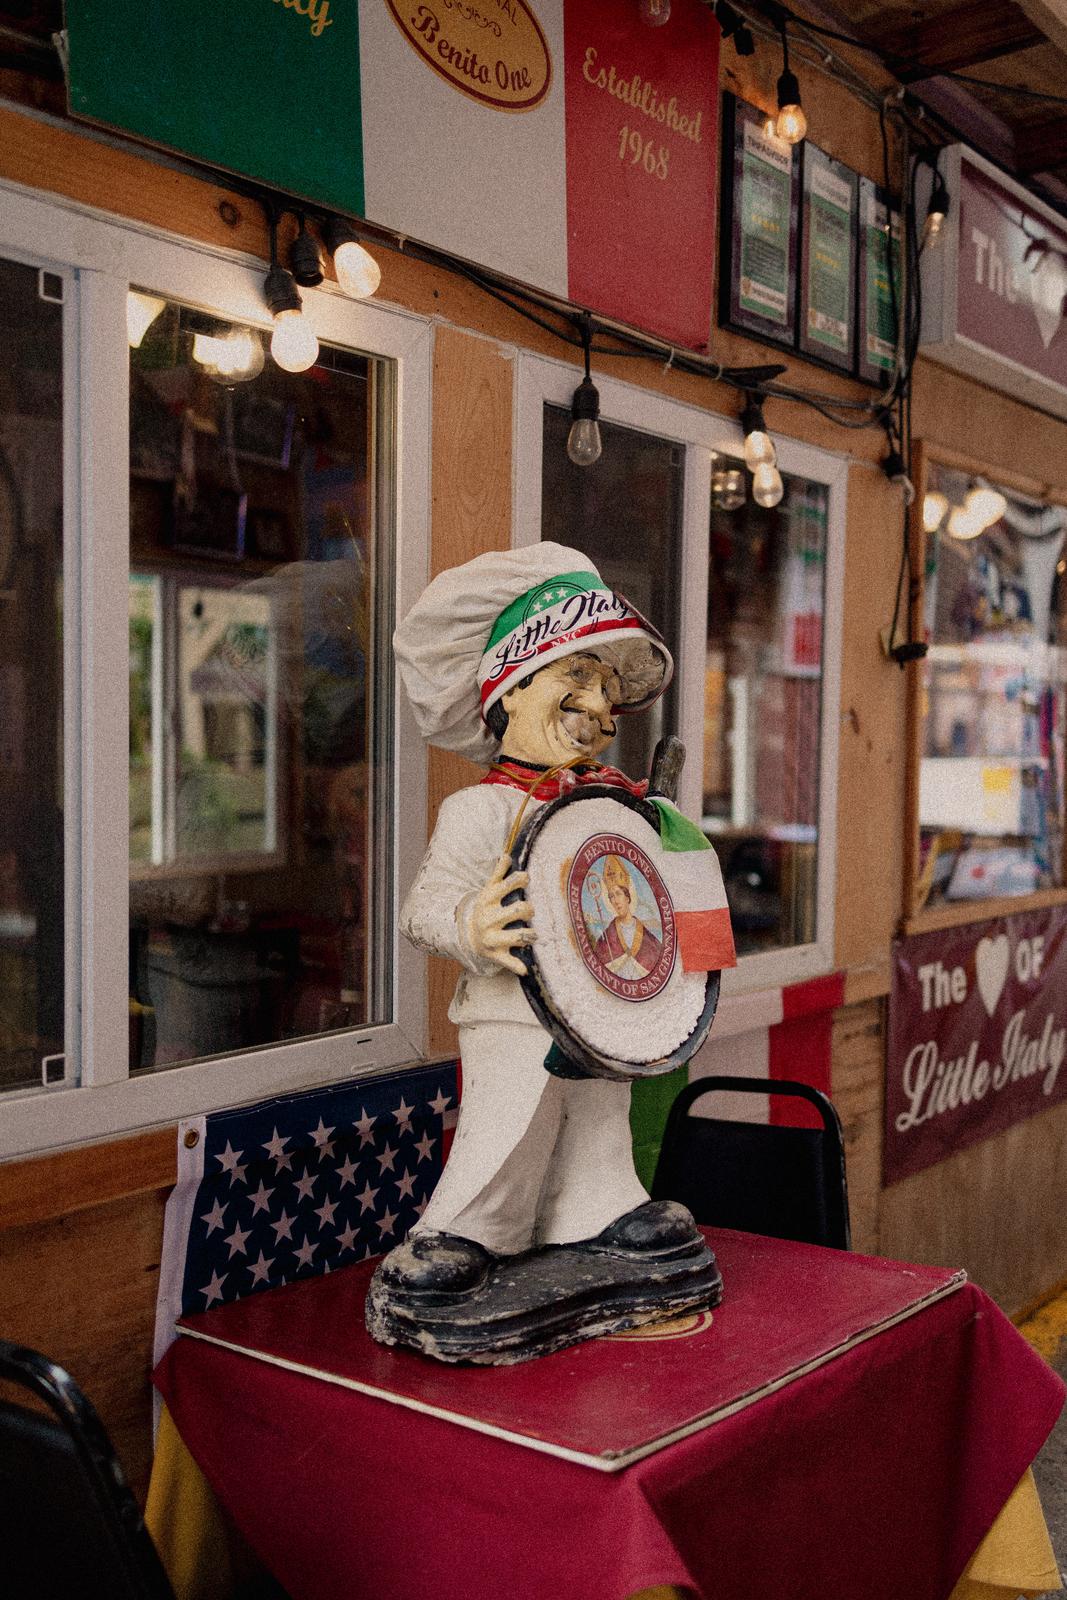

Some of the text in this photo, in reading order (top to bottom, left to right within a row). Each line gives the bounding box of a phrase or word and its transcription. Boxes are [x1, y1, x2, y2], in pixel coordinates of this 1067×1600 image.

[411, 5, 532, 90] Benito One
[583, 47, 705, 144] Established
[619, 126, 671, 181] 1968
[490, 591, 629, 680] Little Italy
[550, 629, 581, 648] NYC
[583, 839, 653, 878] BENITO ONE
[571, 885, 675, 995] RESTAURANT OF SAN GENNARO
[917, 935, 1046, 1012] The OF
[896, 1010, 1067, 1131] Little Italy
